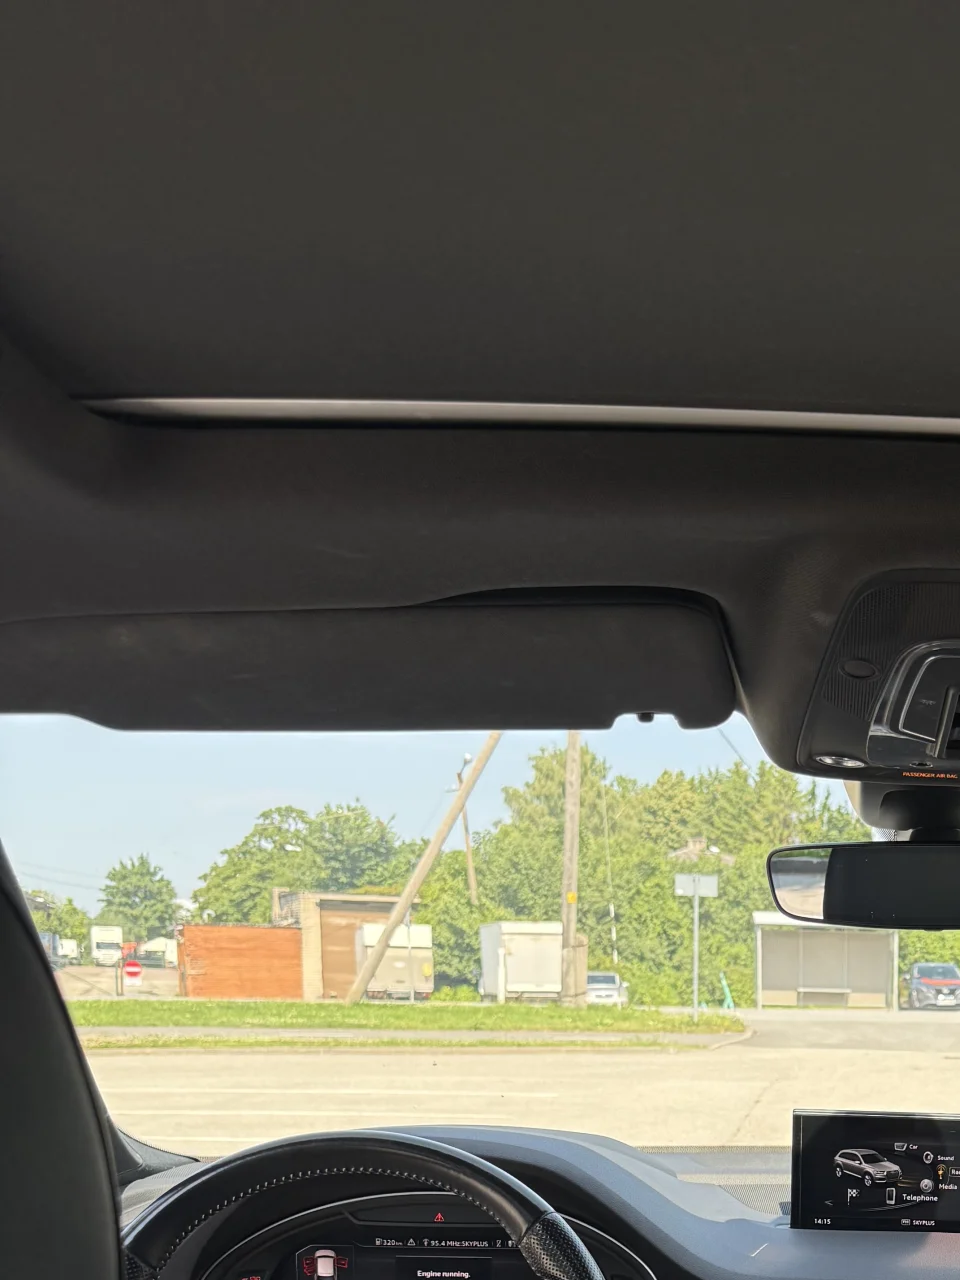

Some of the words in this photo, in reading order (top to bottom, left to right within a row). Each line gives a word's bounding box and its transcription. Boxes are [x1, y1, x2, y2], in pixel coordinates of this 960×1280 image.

[902, 1194, 939, 1202] Telephone
[417, 1270, 442, 1278] Engine
[442, 1271, 471, 1279] running.
